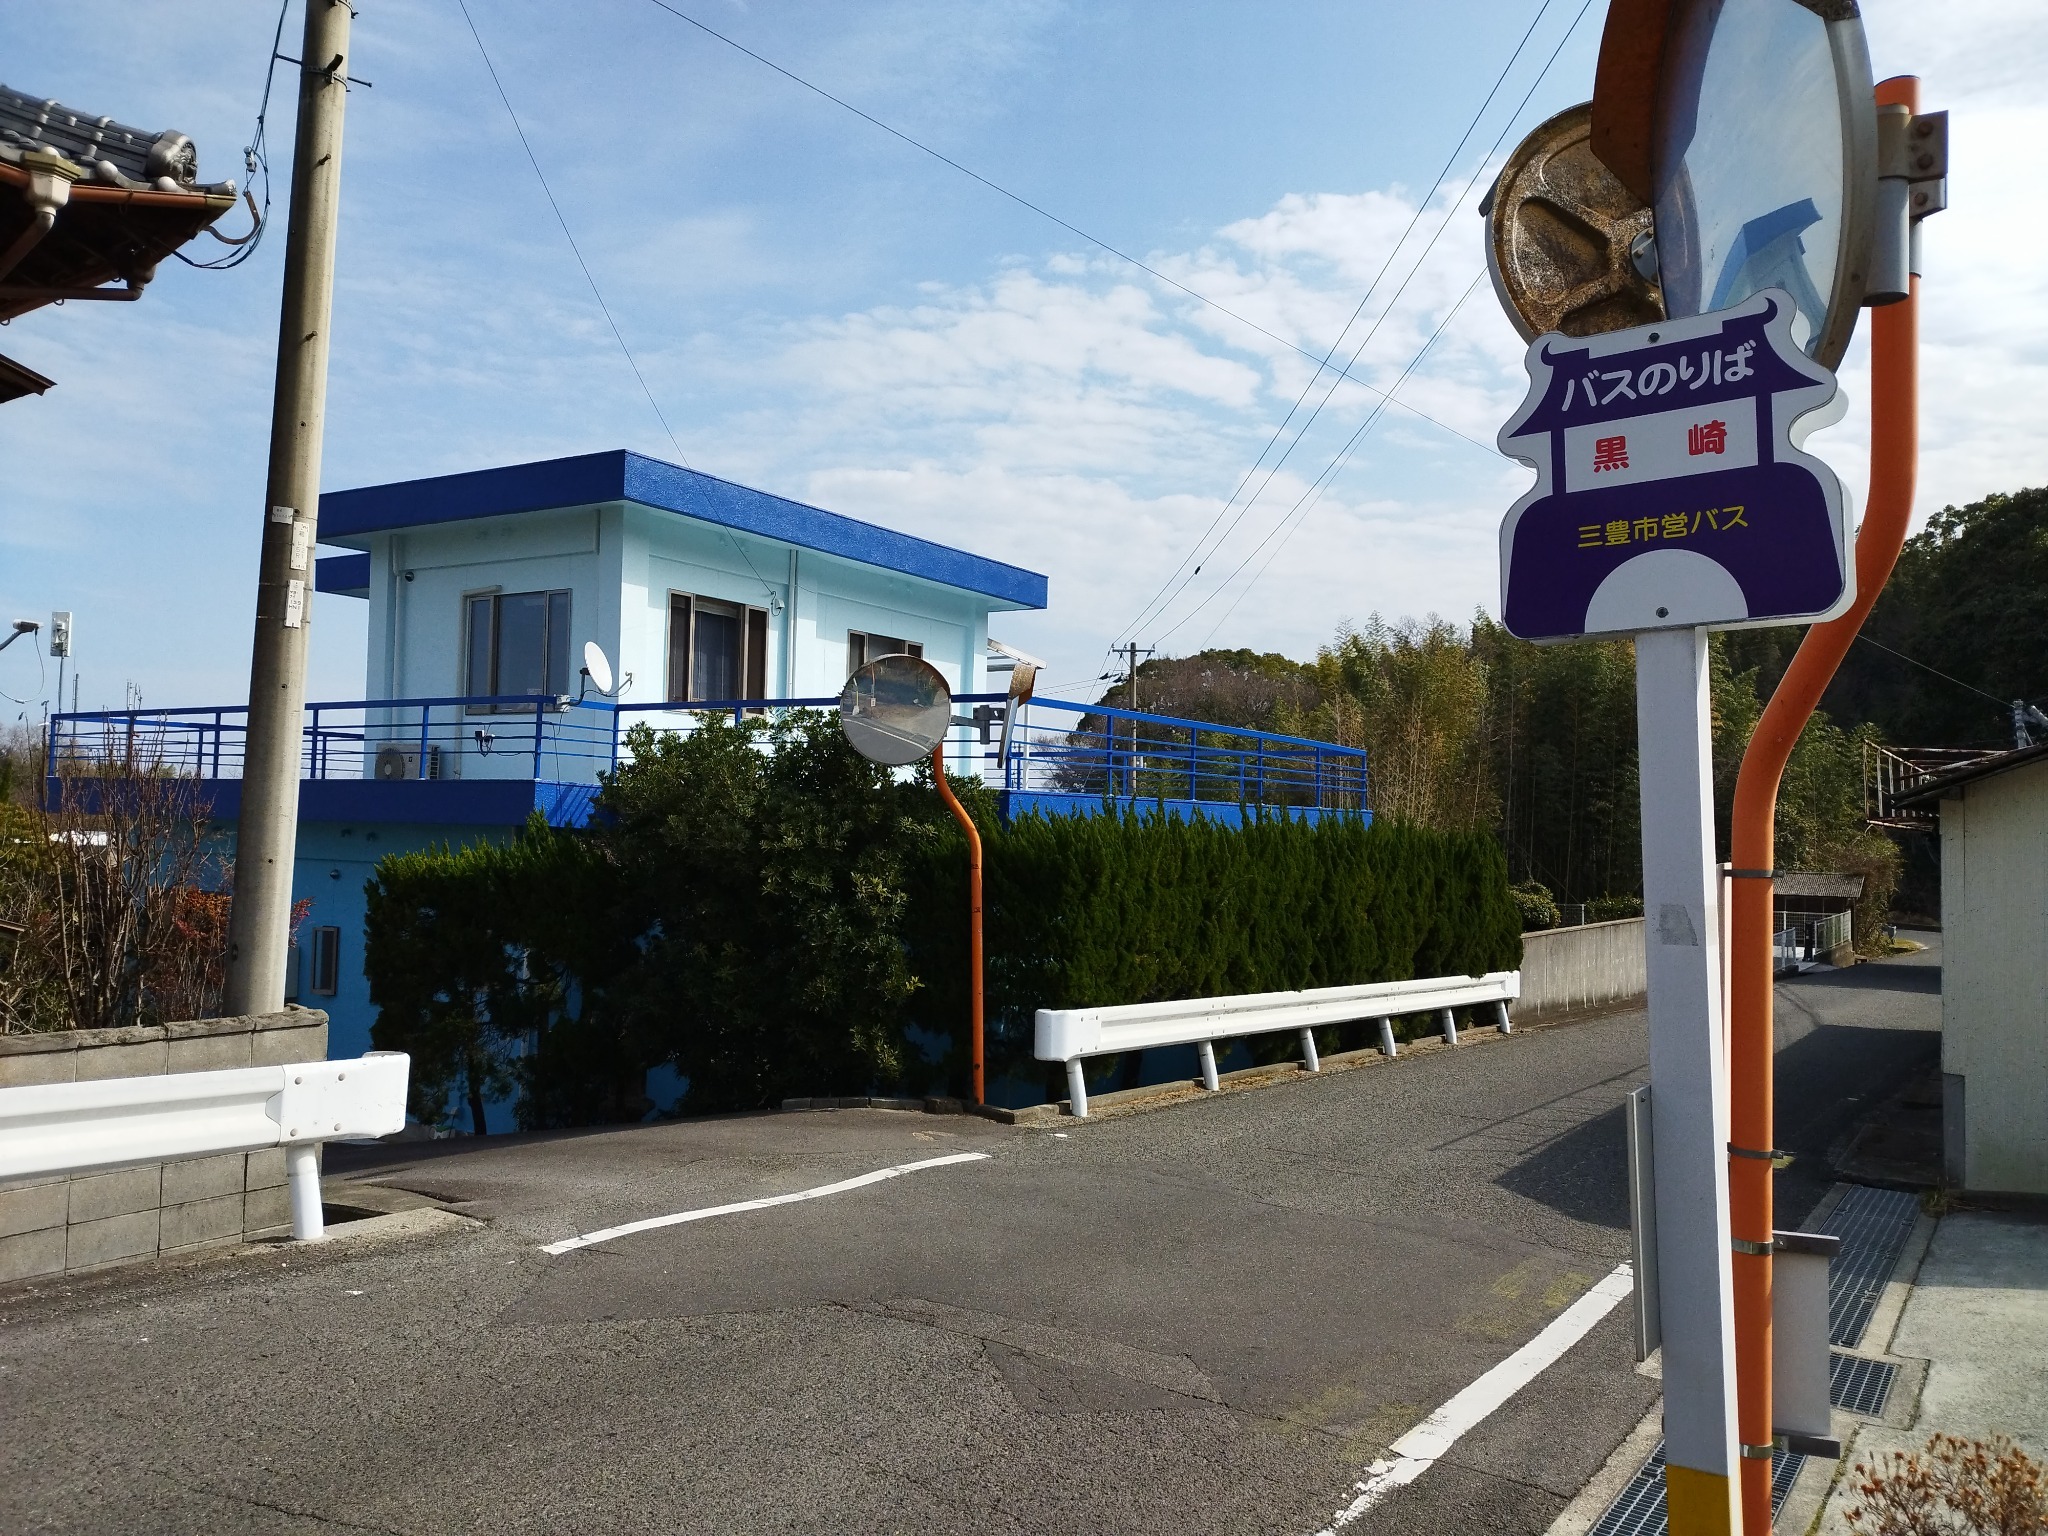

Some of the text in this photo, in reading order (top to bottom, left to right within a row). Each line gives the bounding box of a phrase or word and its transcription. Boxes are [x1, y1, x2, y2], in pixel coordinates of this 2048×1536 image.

[1561, 339, 1757, 411] バスのりば
[1593, 419, 1728, 473] 黒崎
[1577, 505, 1749, 548] 三豊市営バス
